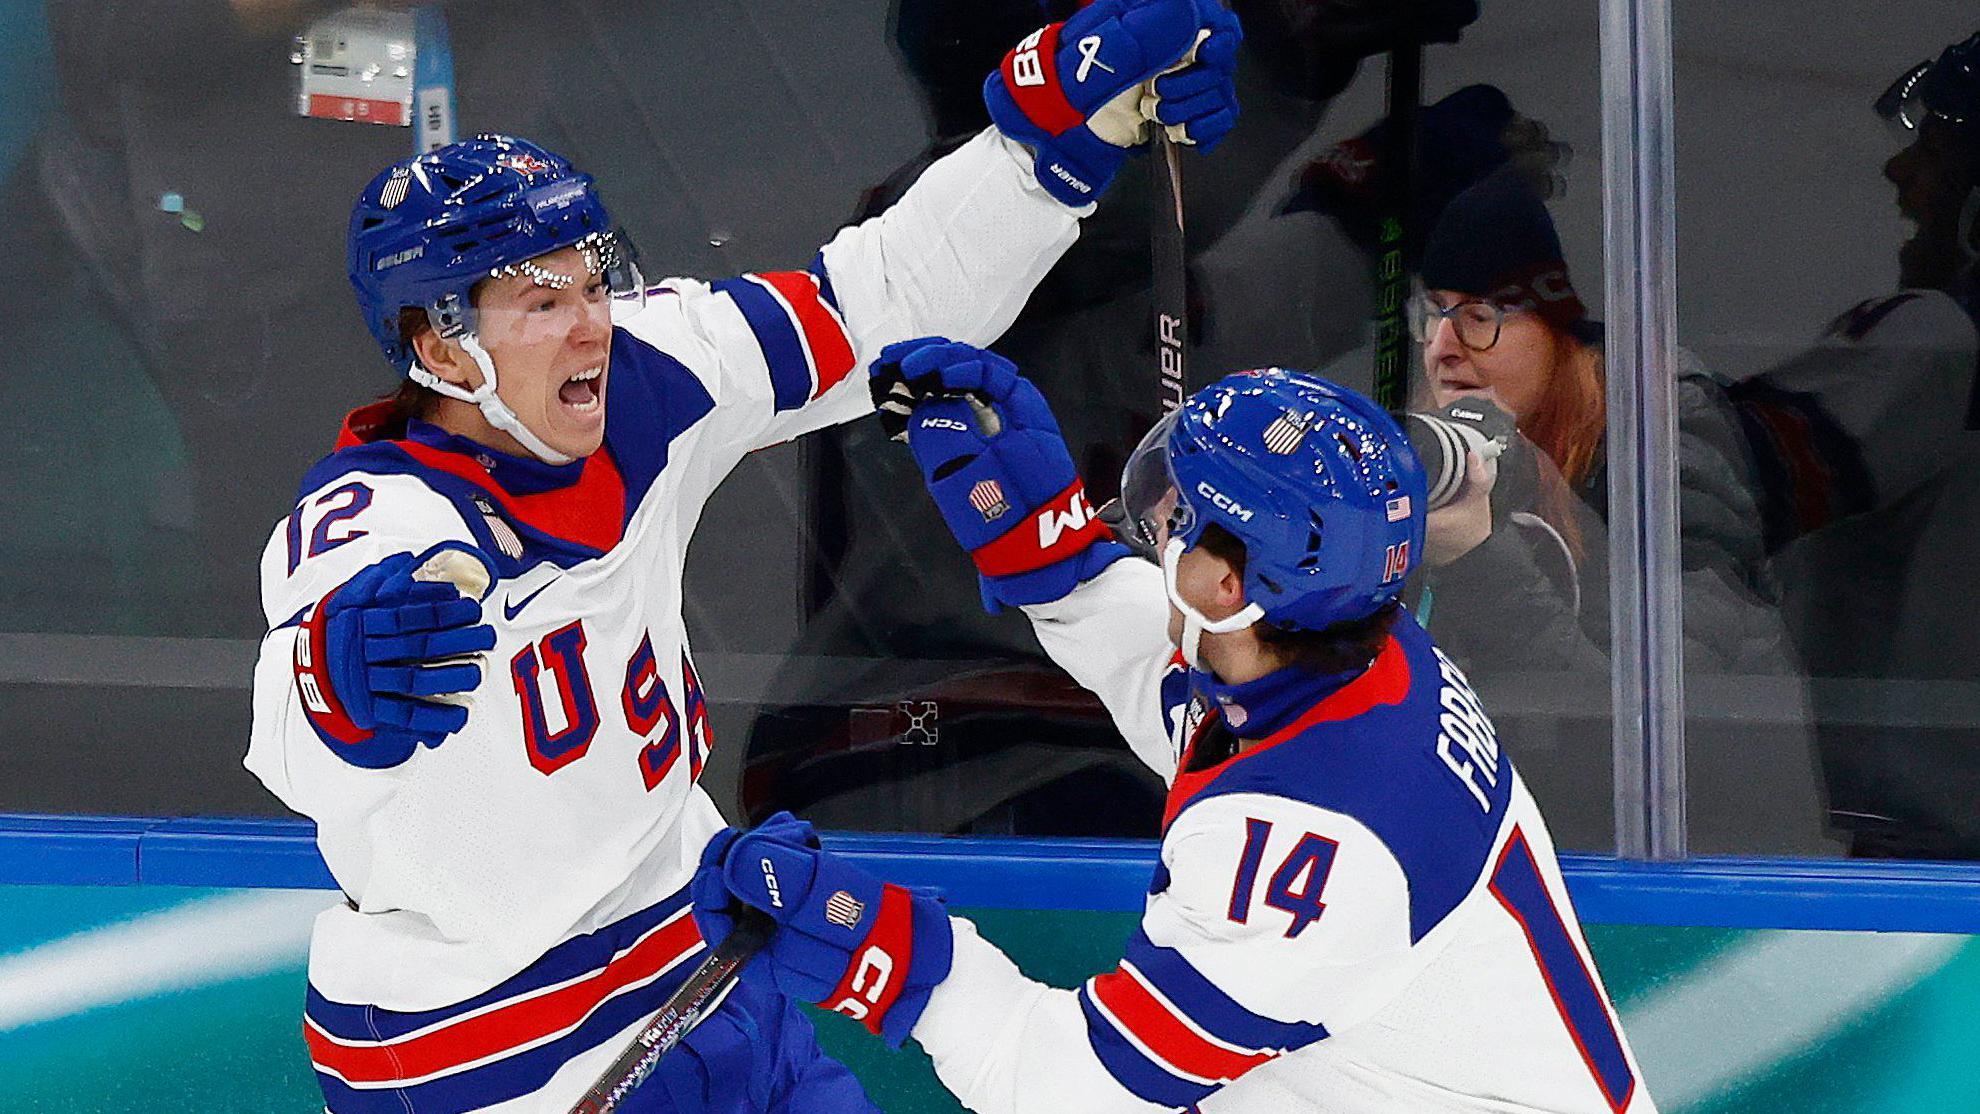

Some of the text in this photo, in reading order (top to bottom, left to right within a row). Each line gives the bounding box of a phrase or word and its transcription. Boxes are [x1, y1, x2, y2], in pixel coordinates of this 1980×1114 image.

[921, 417, 968, 431] CCM
[1197, 480, 1253, 522] CCM
[287, 481, 375, 579] 12
[1382, 539, 1410, 583] 14
[761, 857, 783, 908] CCM
[1227, 817, 1340, 939] 14
